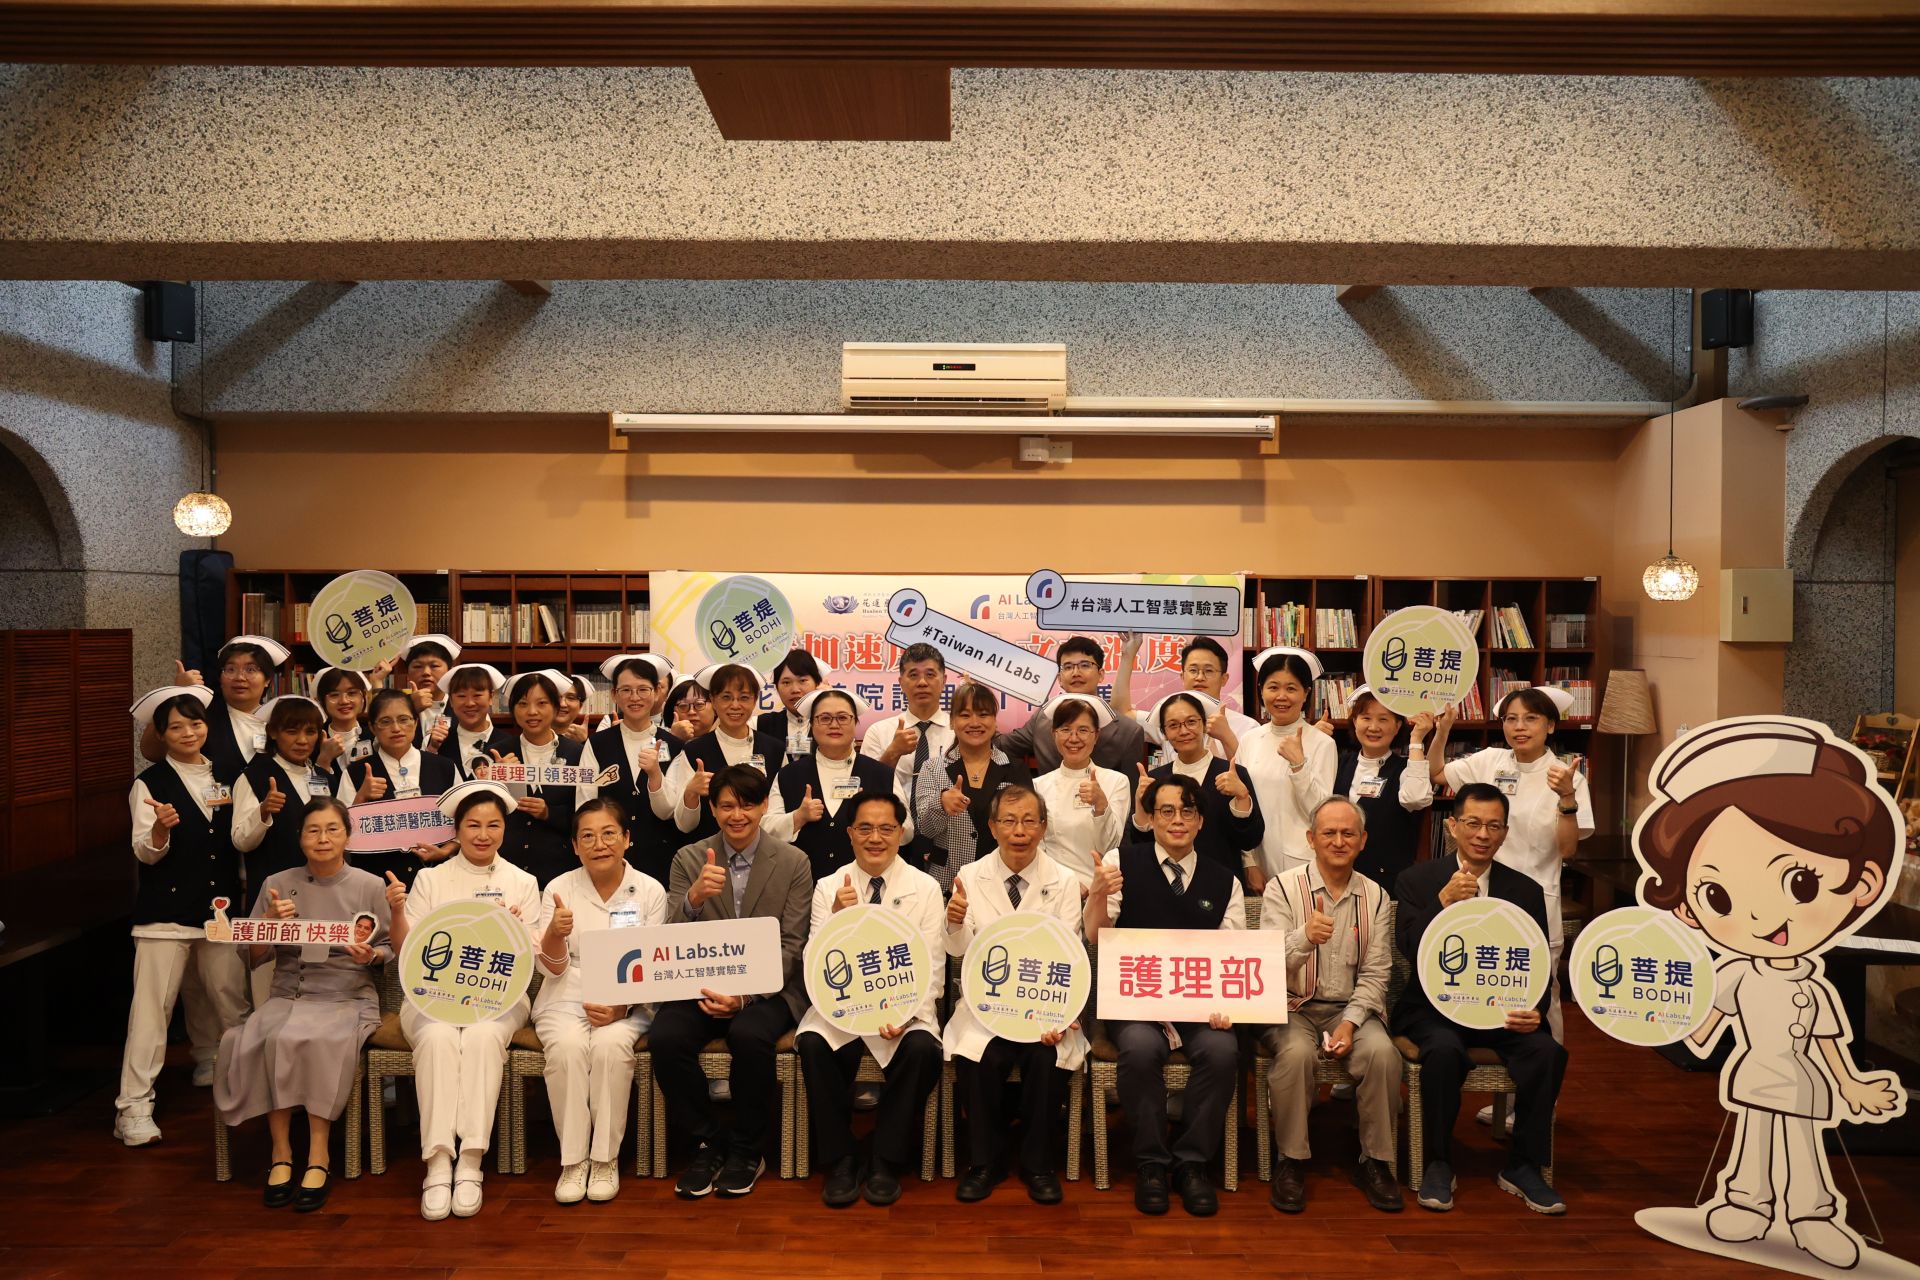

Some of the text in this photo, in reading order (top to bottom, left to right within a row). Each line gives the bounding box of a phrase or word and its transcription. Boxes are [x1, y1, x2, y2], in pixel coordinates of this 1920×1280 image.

[352, 594, 399, 628] 菩提
[999, 594, 1011, 605] AI
[1070, 597, 1228, 617] #台灣人工智慧實驗室
[362, 612, 402, 639] BODHI
[732, 598, 776, 633] 菩提
[744, 617, 782, 644] BODHI
[922, 625, 1041, 685] #Taiwan AI Labs
[1413, 646, 1462, 671] 菩提
[1412, 671, 1458, 685] BODHI
[491, 765, 595, 784] 護理引領發聲
[459, 945, 516, 977] 菩提
[652, 942, 746, 962] AI Labs.tw
[856, 943, 913, 976] 菩提
[1475, 944, 1530, 972] 菩提
[455, 972, 508, 992] BODHI
[653, 964, 748, 981] 台灣人工智慧實驗室
[863, 970, 915, 992] BODHI
[1017, 957, 1071, 988] 菩提
[1119, 954, 1264, 1000] 護理部
[1476, 973, 1528, 988] BODHI
[1630, 956, 1693, 987] 菩提
[1016, 986, 1067, 1004] BODHI
[1633, 987, 1691, 1005] BODHI
